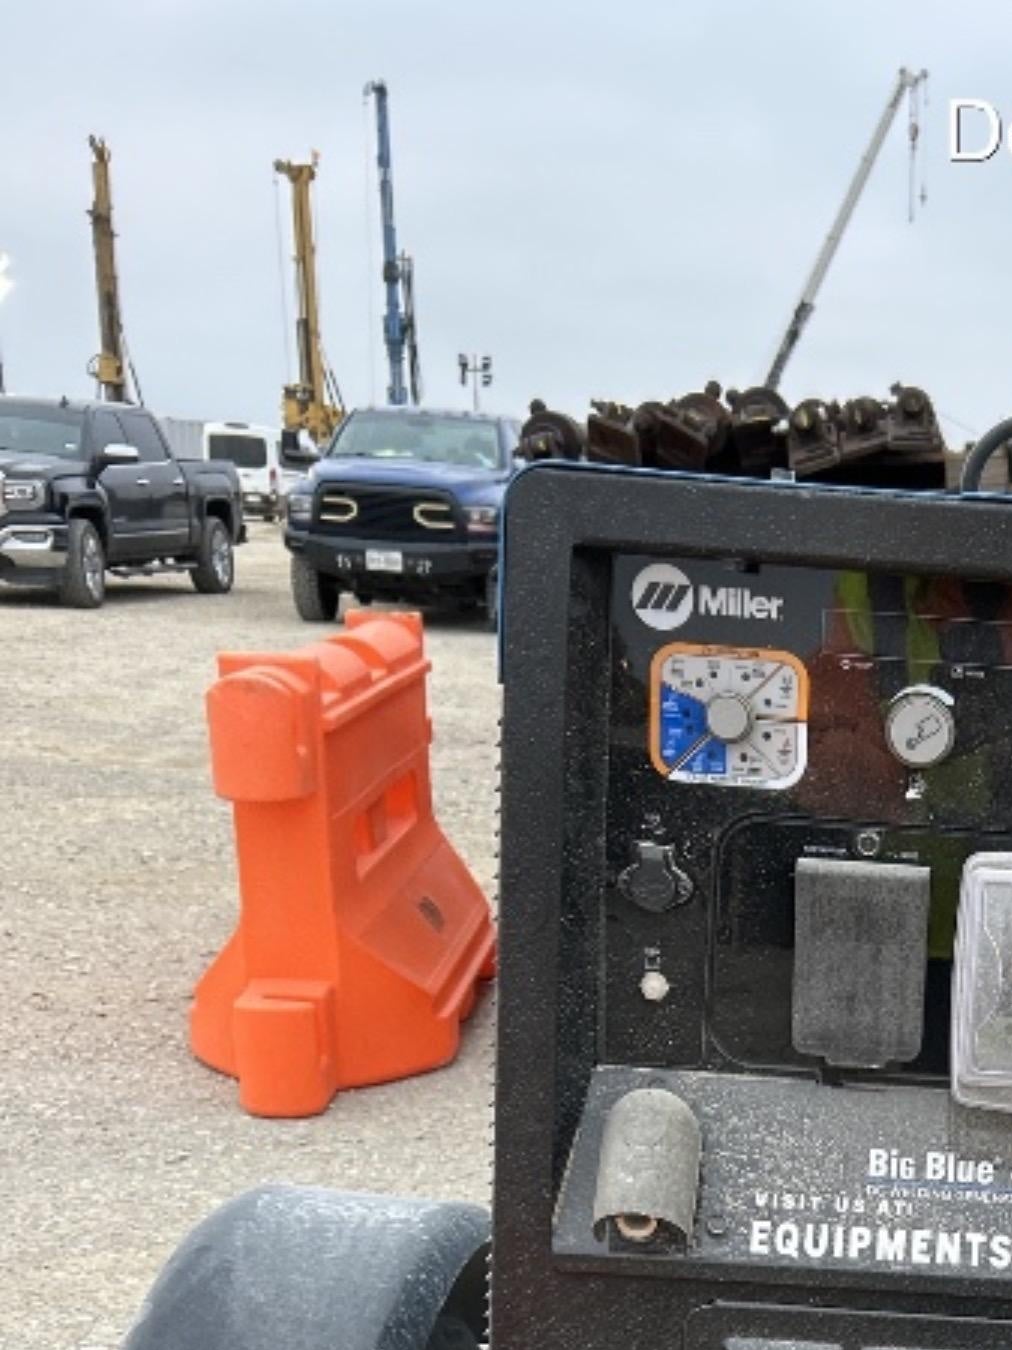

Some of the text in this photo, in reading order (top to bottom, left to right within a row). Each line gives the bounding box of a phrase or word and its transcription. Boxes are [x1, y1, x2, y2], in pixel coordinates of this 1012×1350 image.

[699, 584, 785, 620] Miller
[926, 1151, 995, 1185] Blue
[755, 1191, 823, 1211] VISIT
[835, 1195, 866, 1214] US
